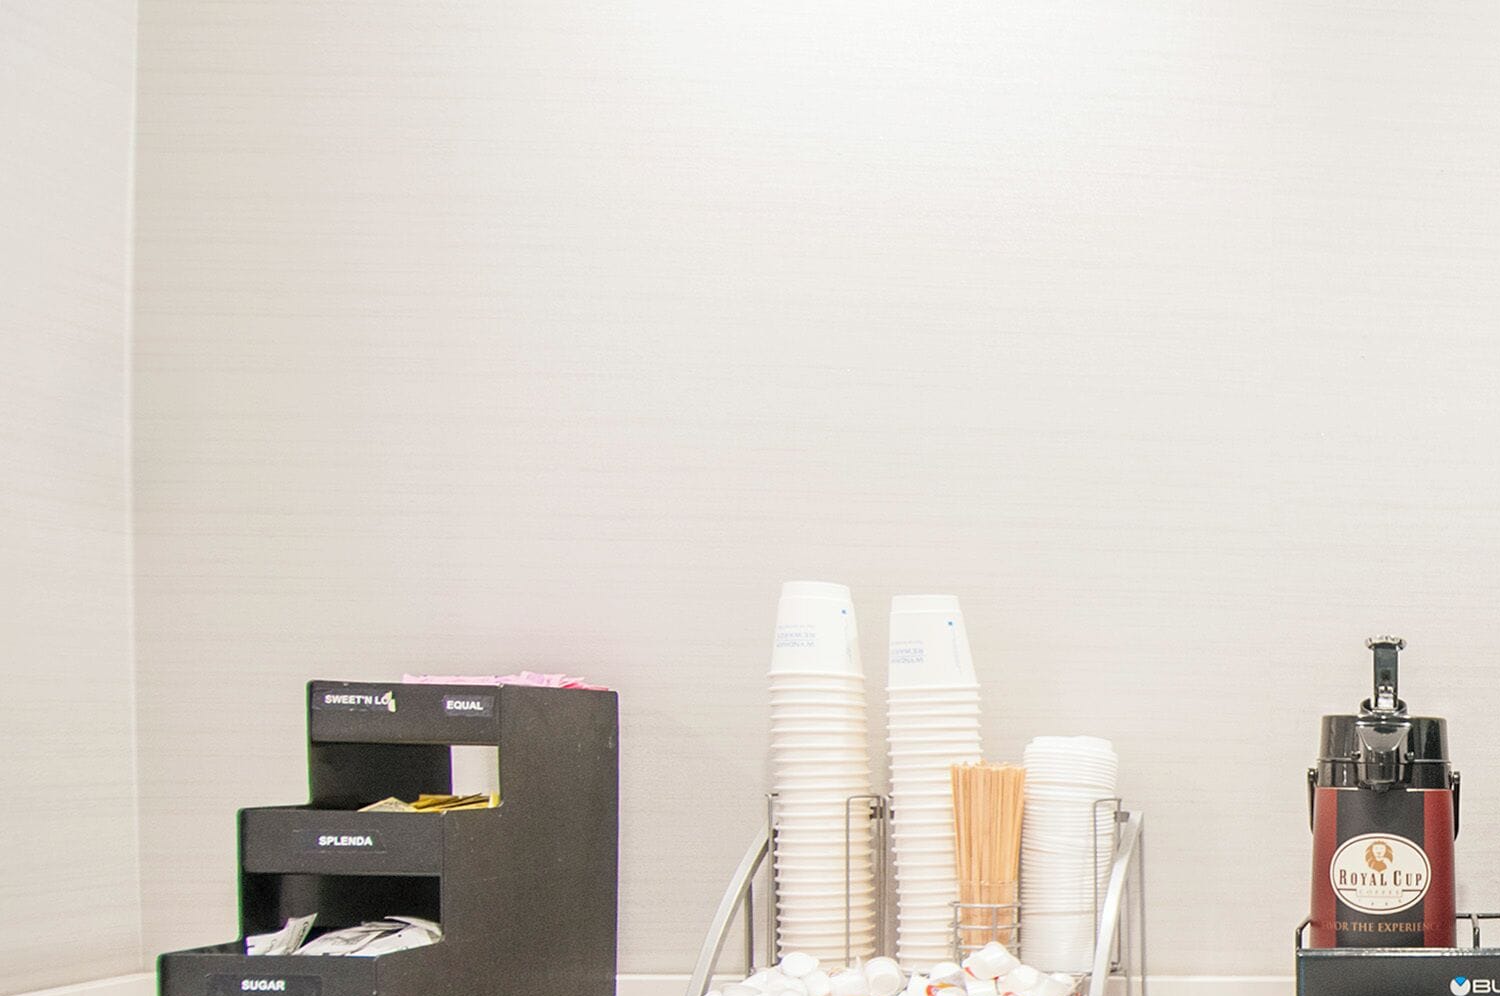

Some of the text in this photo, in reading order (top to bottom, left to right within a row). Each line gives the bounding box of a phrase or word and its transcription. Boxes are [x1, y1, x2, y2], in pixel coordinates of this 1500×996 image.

[324, 692, 393, 708] SWEET'N LO
[446, 700, 484, 710] EQUAL
[318, 835, 373, 846] SPLENDA
[1351, 922, 1375, 932] THE
[241, 979, 286, 991] SUGAR
